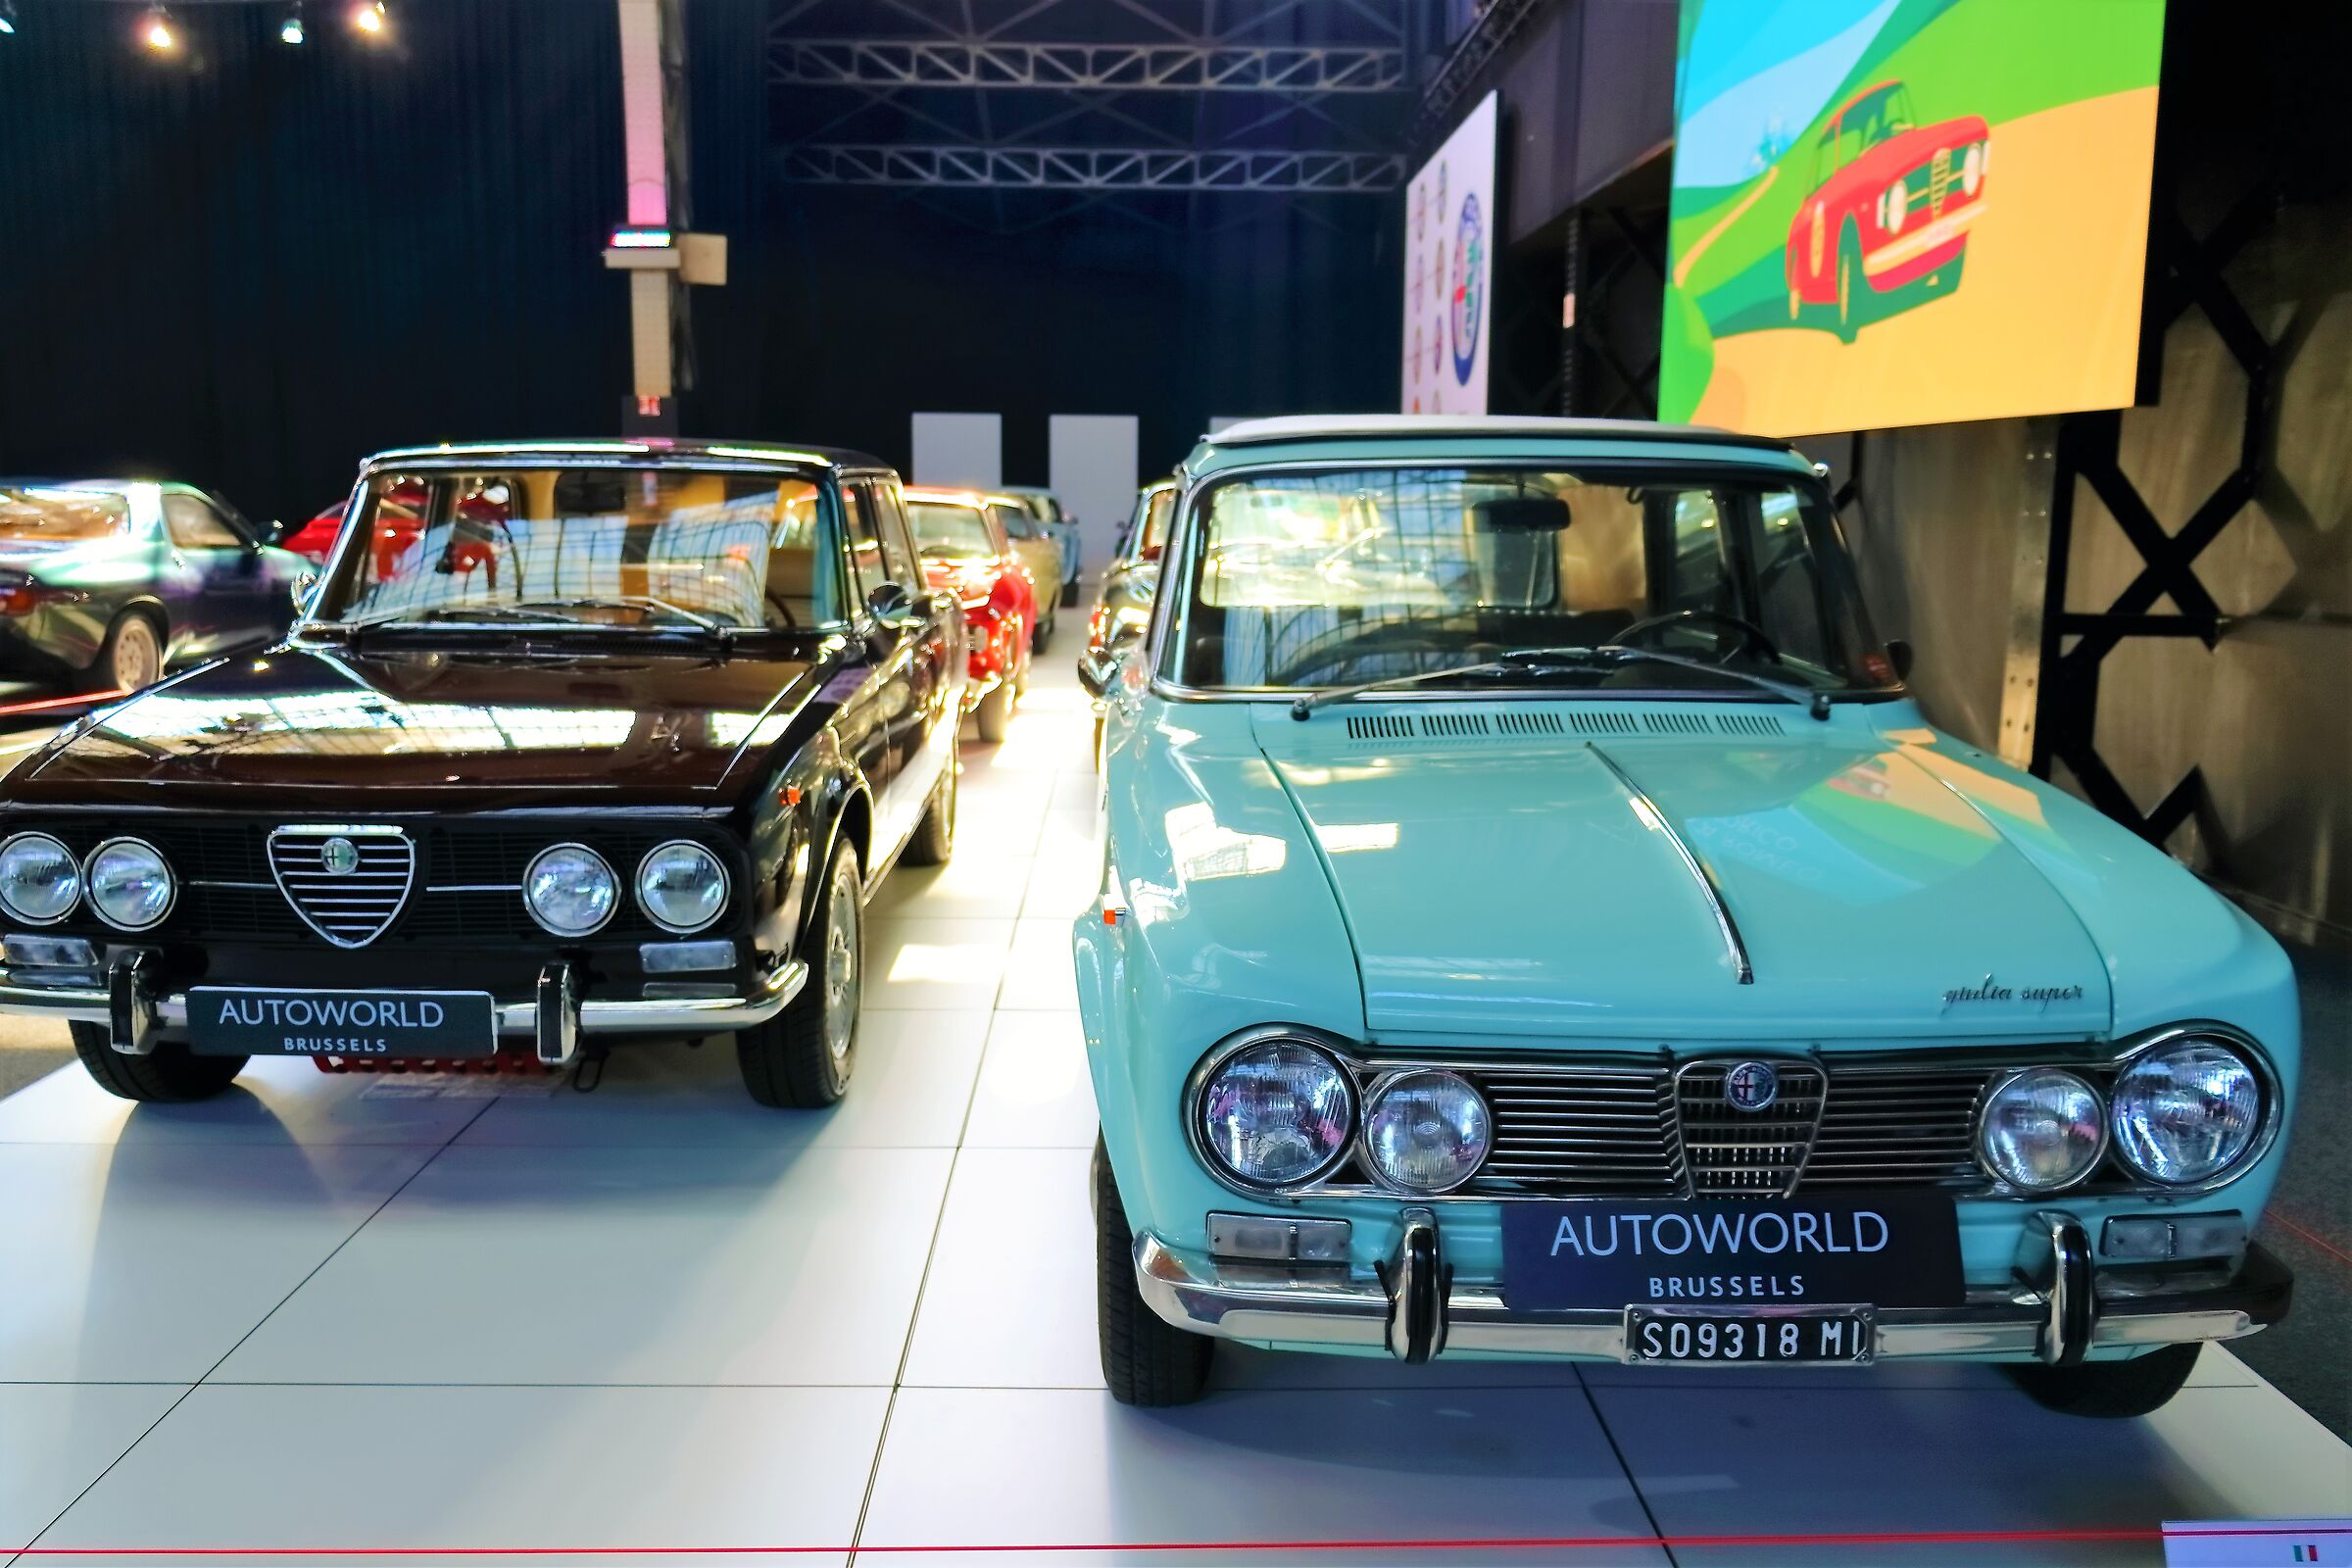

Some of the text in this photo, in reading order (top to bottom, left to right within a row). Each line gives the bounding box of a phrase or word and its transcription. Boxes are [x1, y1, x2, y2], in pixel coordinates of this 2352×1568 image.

[2020, 984, 2083, 1013] super
[218, 999, 445, 1028] AUTOWORLD
[283, 1037, 387, 1053] BRUSSELS
[1549, 1210, 1889, 1256] AUTOWORLD
[1649, 1275, 1805, 1298] BRUSSELS
[1642, 1321, 1861, 1358] S09318 MI
